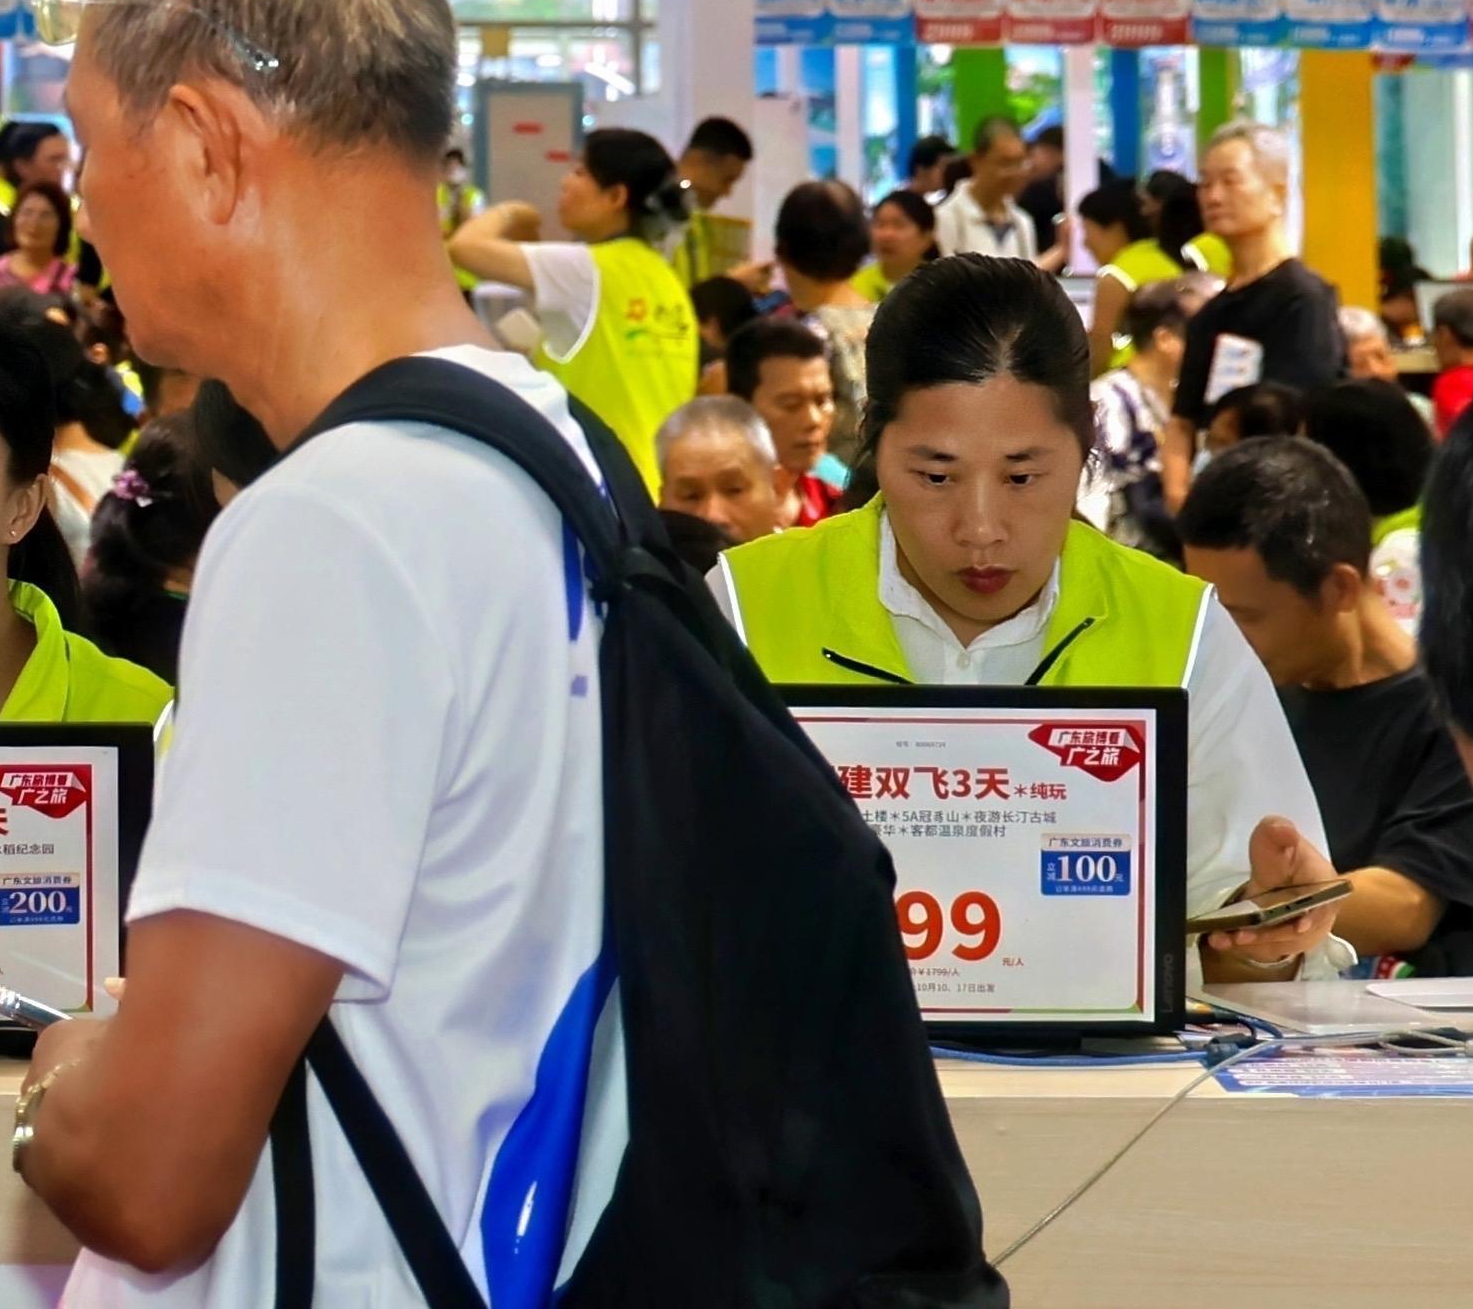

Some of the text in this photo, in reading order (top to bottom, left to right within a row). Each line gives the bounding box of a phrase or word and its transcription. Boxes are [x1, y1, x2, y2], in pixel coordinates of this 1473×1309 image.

[1066, 747, 1121, 766] 广之旅
[831, 766, 1010, 800] 建双飞3天
[17, 788, 68, 805] 广之旅
[1056, 855, 1116, 882] 100
[9, 892, 67, 915] 200
